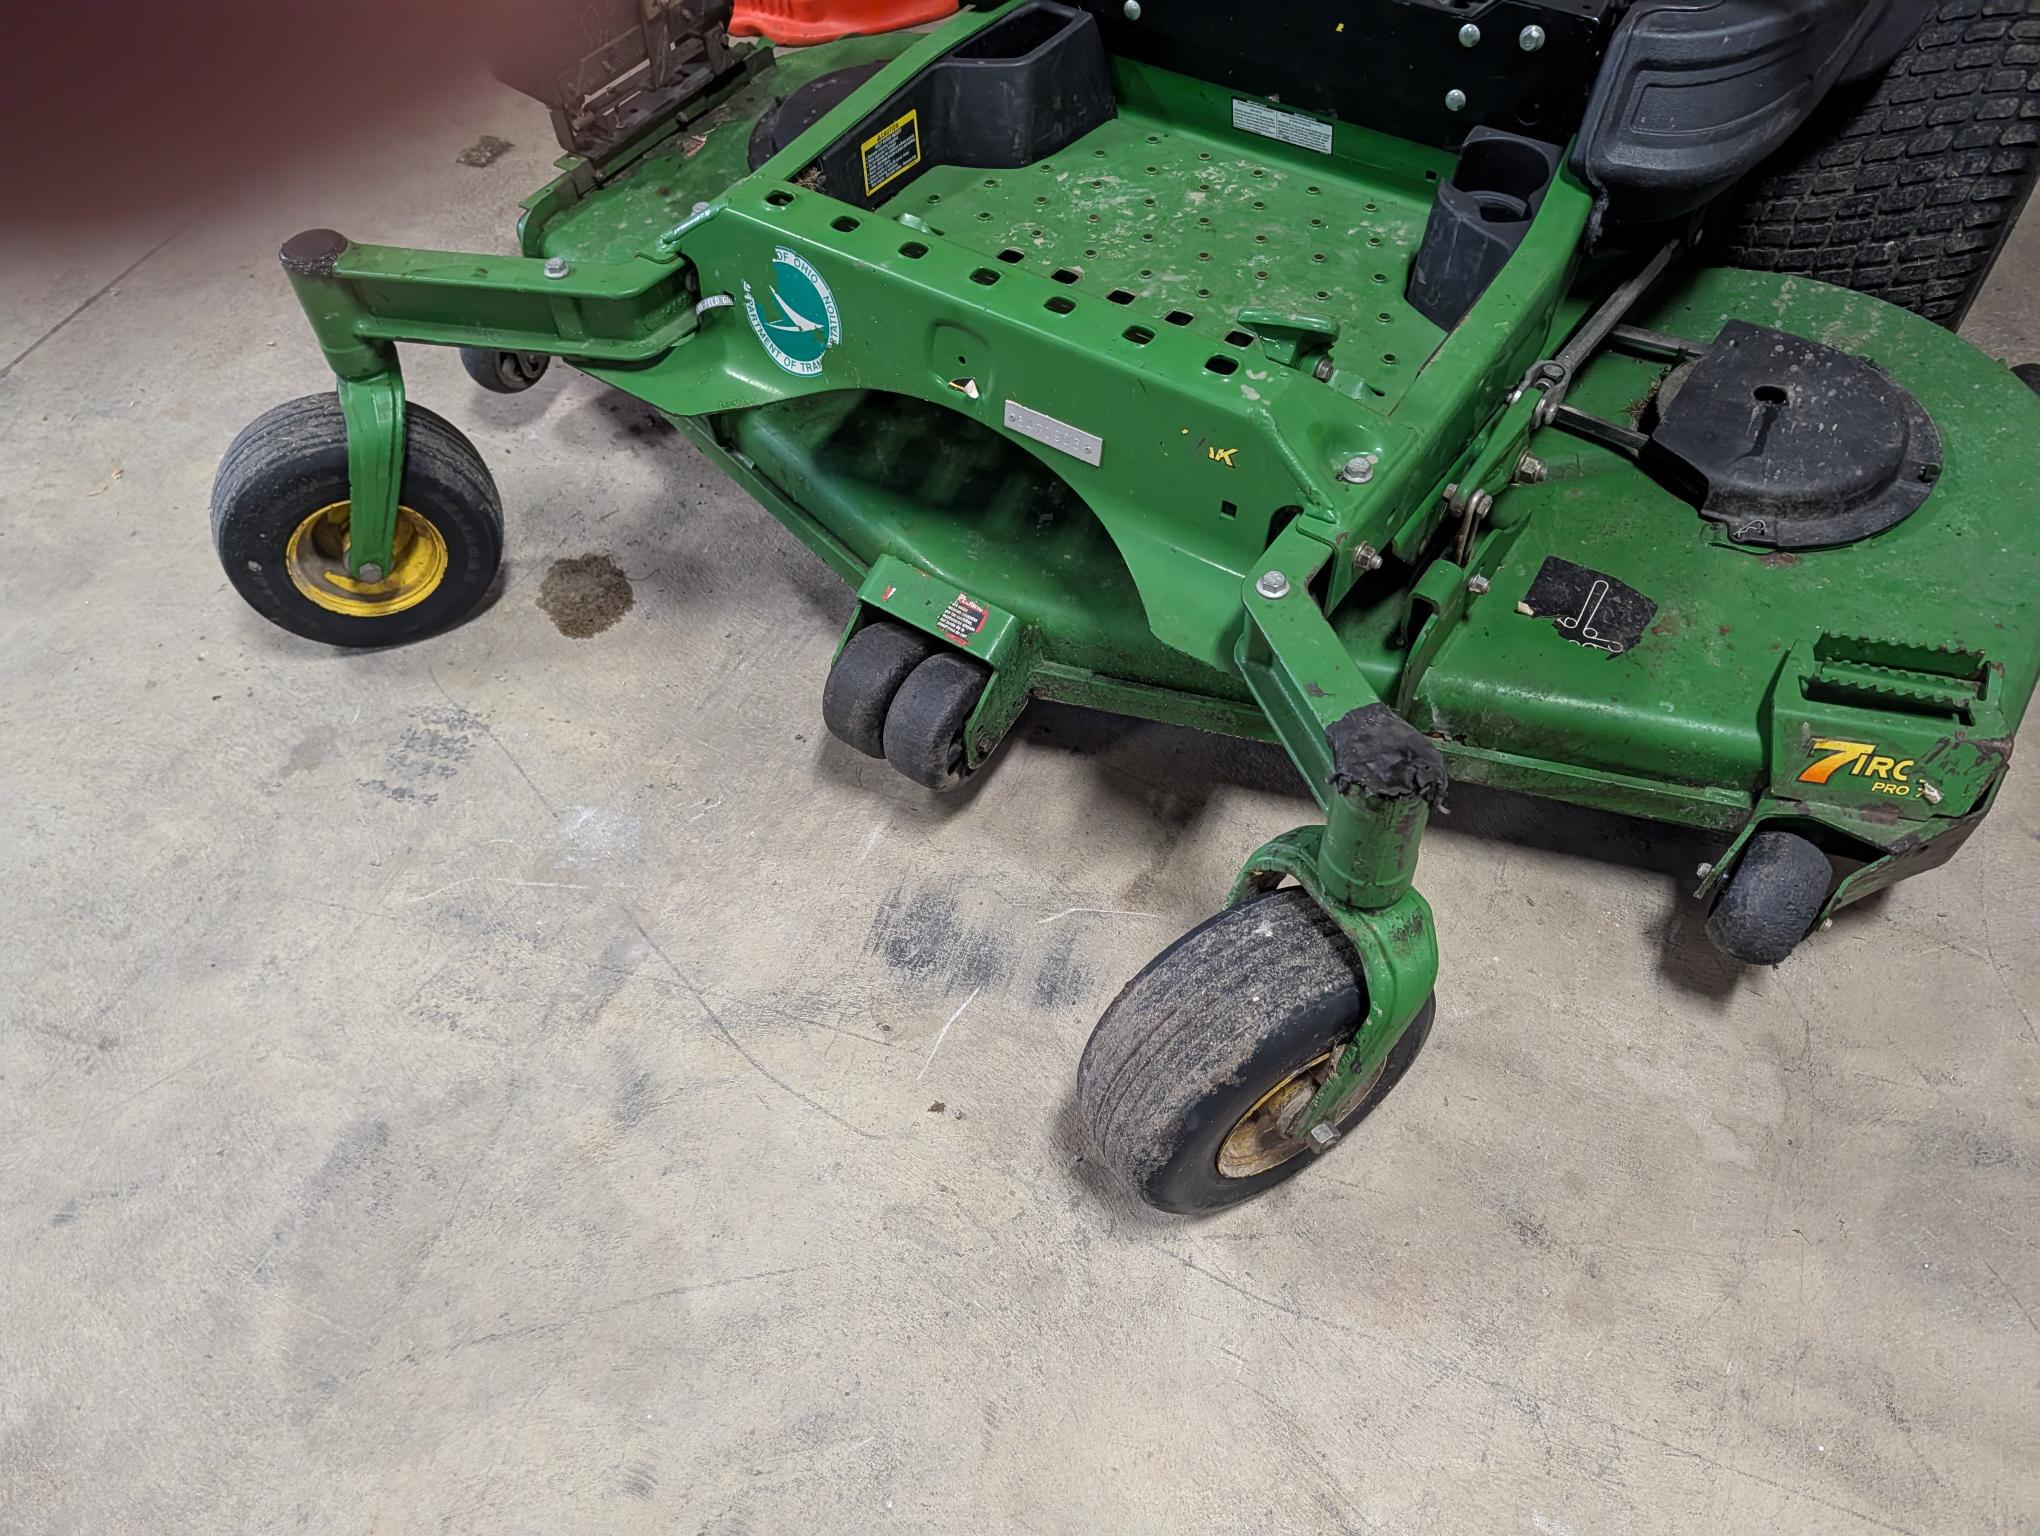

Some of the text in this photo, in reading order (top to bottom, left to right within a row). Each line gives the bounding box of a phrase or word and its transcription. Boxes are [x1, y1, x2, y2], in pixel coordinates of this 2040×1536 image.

[793, 258, 818, 284] OHIO
[783, 356, 797, 369] OF
[1871, 782, 1910, 796] PRO
